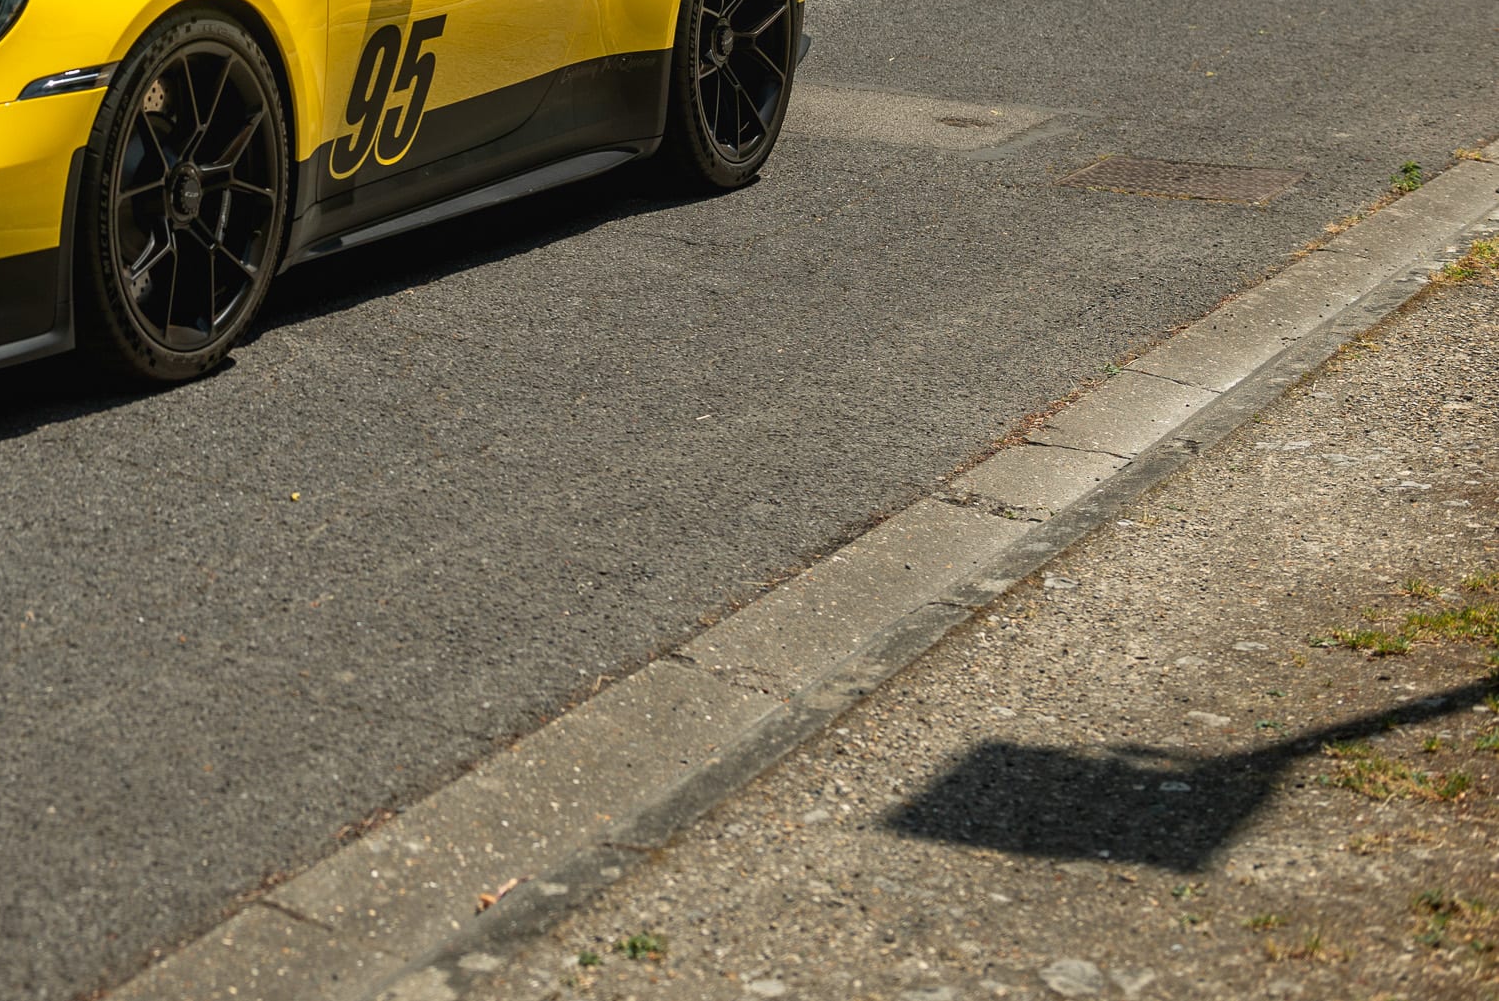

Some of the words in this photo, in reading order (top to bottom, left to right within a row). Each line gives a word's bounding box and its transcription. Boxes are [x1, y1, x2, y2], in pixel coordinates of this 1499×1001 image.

[688, 2, 699, 79] MICHELIN
[329, 13, 448, 180] 95
[98, 170, 113, 275] MICHELIN
